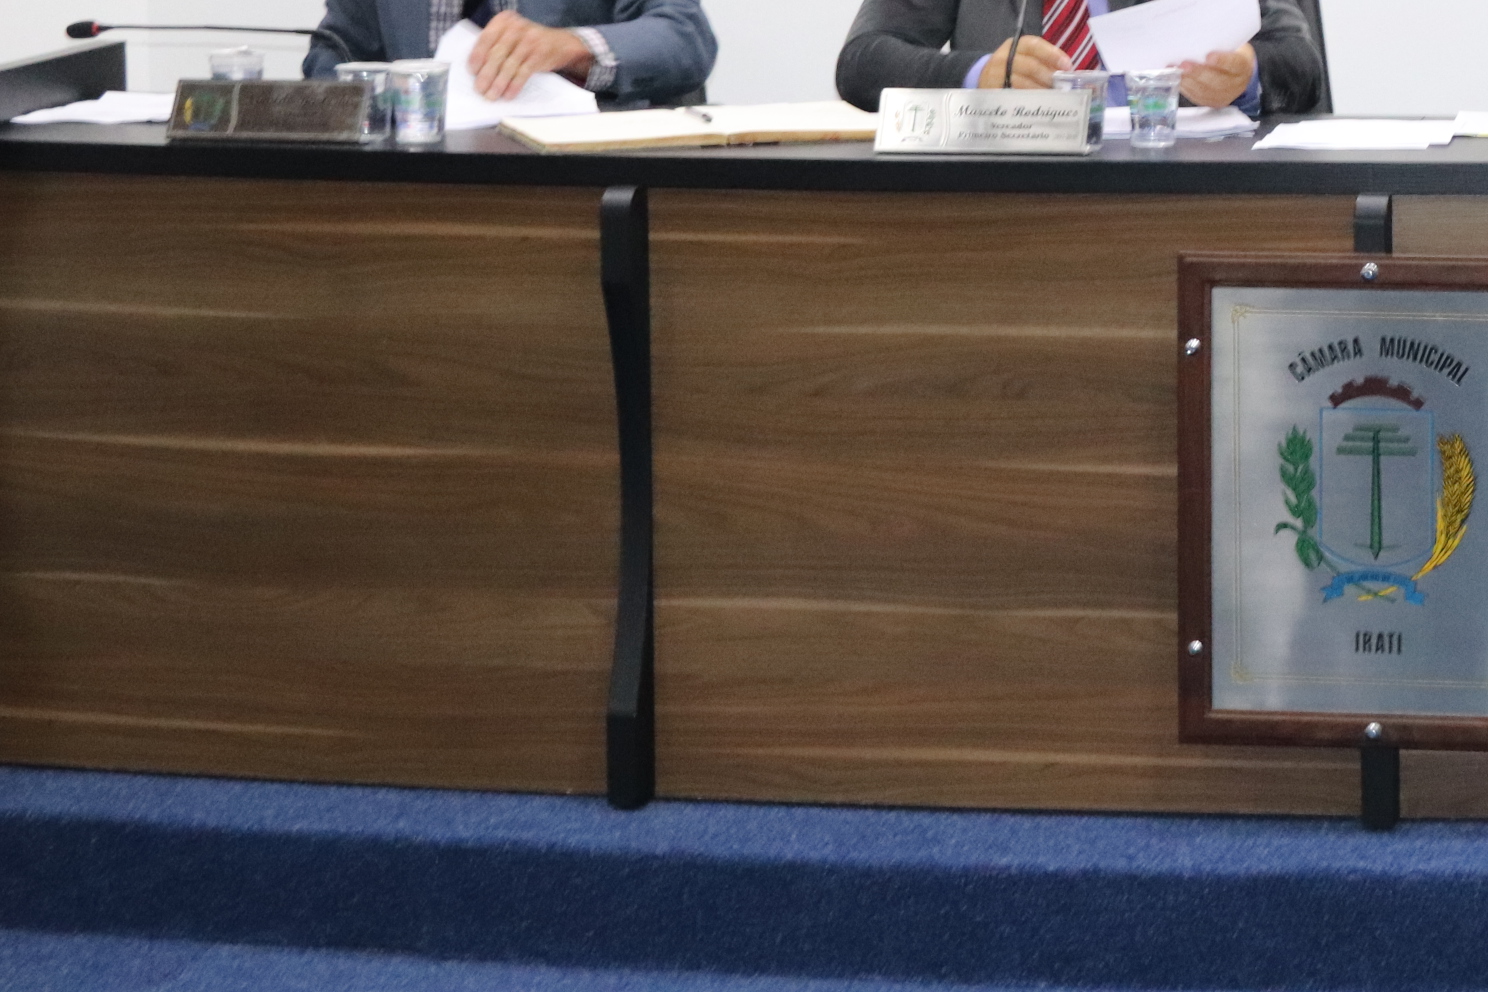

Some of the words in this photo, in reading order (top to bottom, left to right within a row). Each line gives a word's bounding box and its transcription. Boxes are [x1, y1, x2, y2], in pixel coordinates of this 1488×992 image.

[954, 104, 1008, 118] Marcelo
[1012, 104, 1079, 121] Rodrigues
[1287, 334, 1365, 384] CÂMARA
[1379, 333, 1472, 388] MUNICIPAL
[1354, 630, 1403, 655] IRATI
